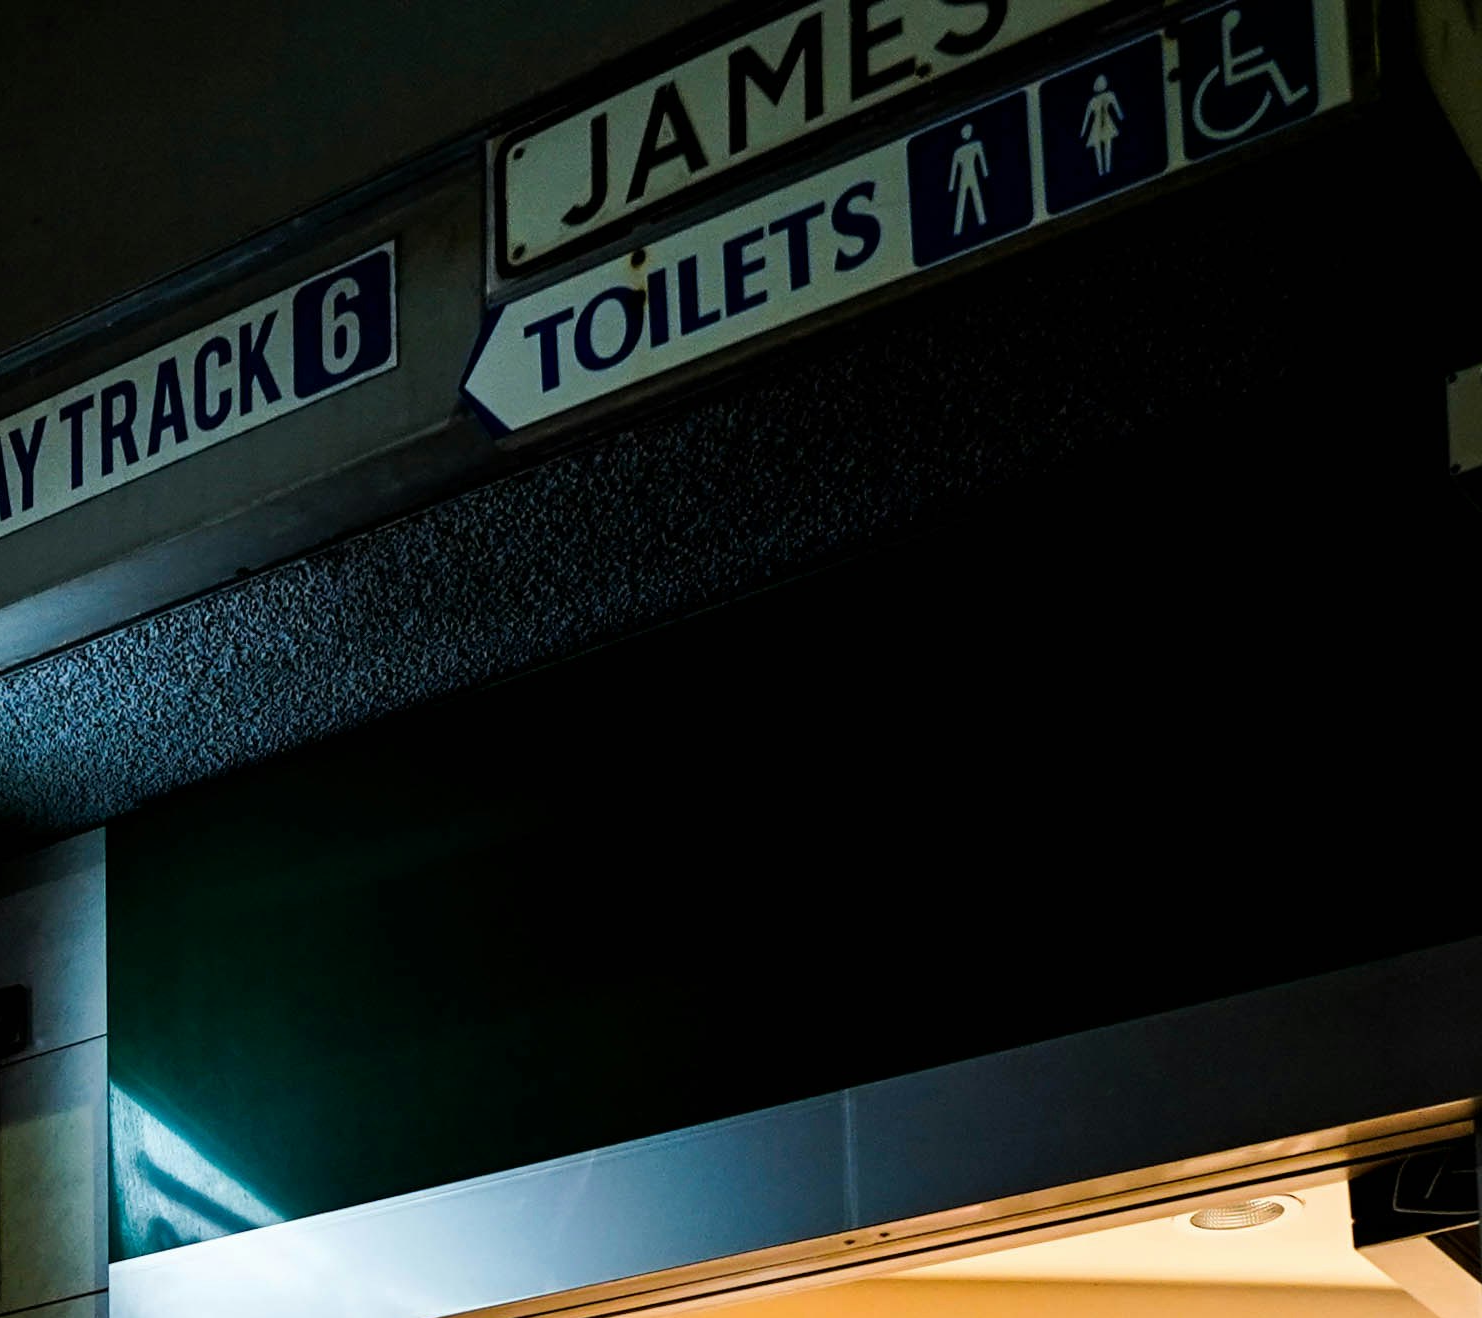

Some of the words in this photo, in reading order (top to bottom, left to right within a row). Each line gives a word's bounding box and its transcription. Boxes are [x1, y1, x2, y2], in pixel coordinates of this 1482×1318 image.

[59, 310, 284, 490] TRACK
[320, 276, 362, 375] 6
[524, 181, 881, 393] TOILETS
